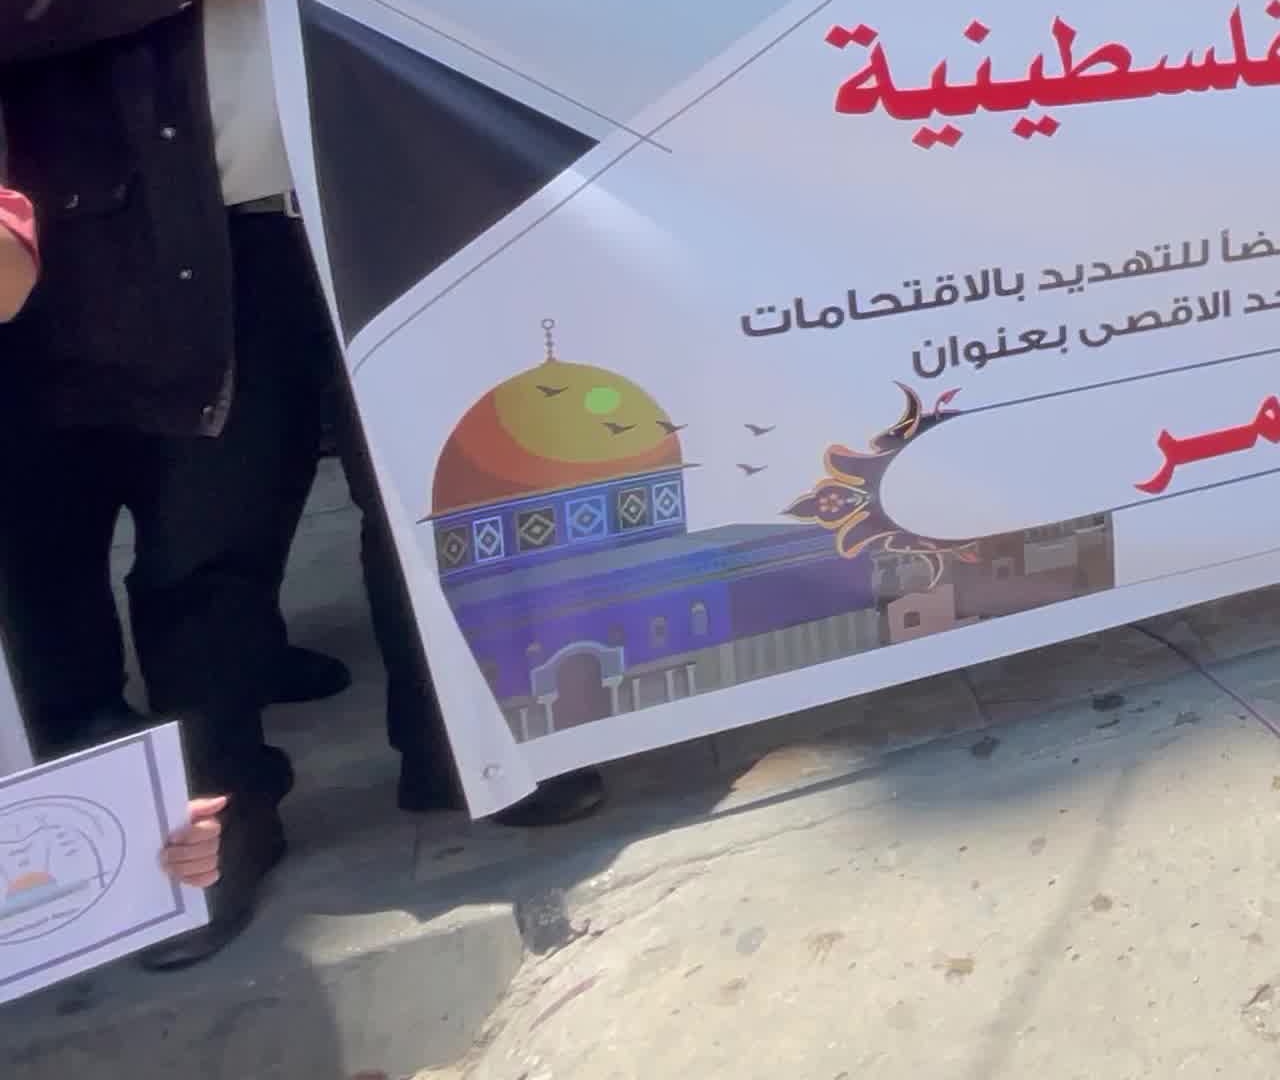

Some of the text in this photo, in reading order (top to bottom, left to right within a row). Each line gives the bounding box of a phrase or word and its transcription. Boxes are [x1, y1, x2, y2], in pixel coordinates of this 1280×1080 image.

[1038, 239, 1209, 294] للتهديد
[741, 268, 1025, 338] بالاقتحامات
[1078, 286, 1231, 347] الاقصى
[912, 325, 1068, 379] بعنوان
